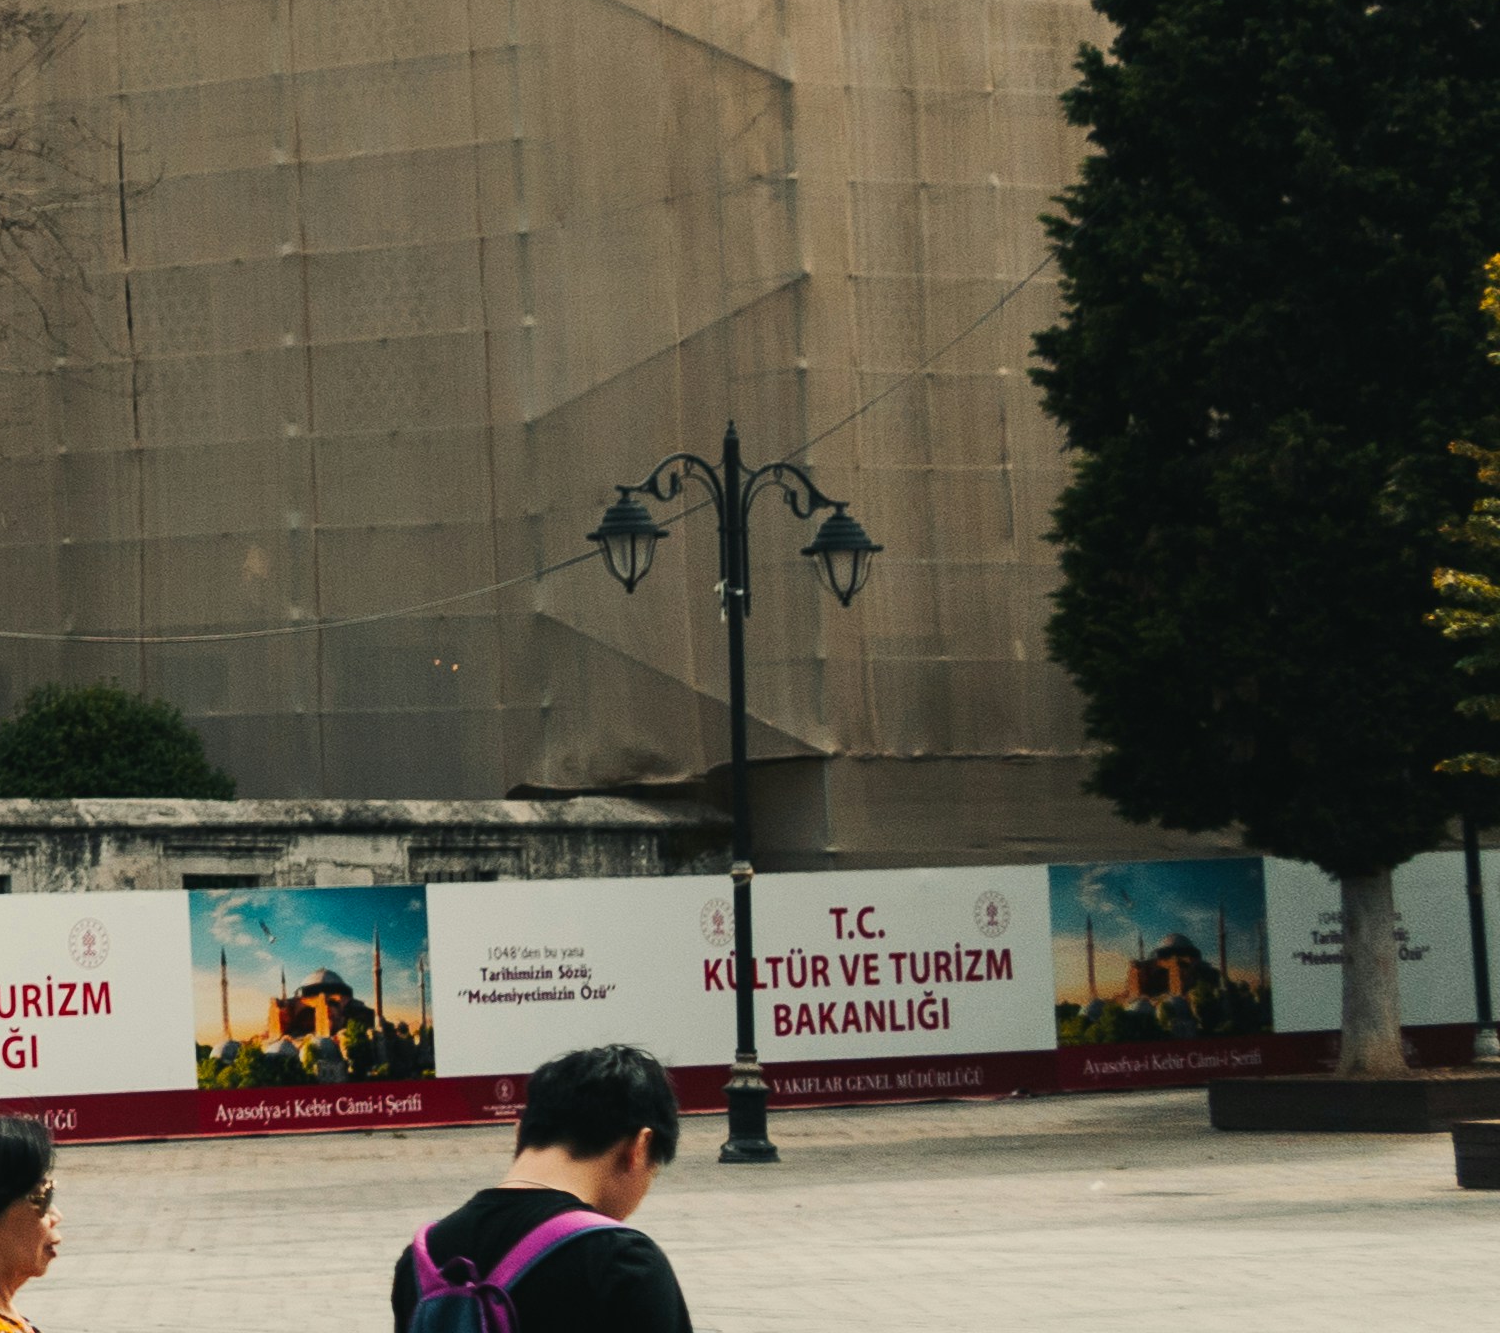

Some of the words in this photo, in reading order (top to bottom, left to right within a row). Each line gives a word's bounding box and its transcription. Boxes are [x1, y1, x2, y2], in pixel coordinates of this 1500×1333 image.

[829, 905, 886, 939] T.C.
[544, 946, 558, 959] bu
[839, 953, 881, 986] VE
[888, 941, 1014, 984] TURİZM
[480, 965, 553, 982] Tarihimizin
[558, 964, 592, 982] Sözü;
[773, 990, 951, 1037] BAKANLIĞI
[846, 1073, 894, 1092] GENEL
[215, 1099, 291, 1127] Ayasofya-i
[336, 1095, 383, 1115] Câmi-i
